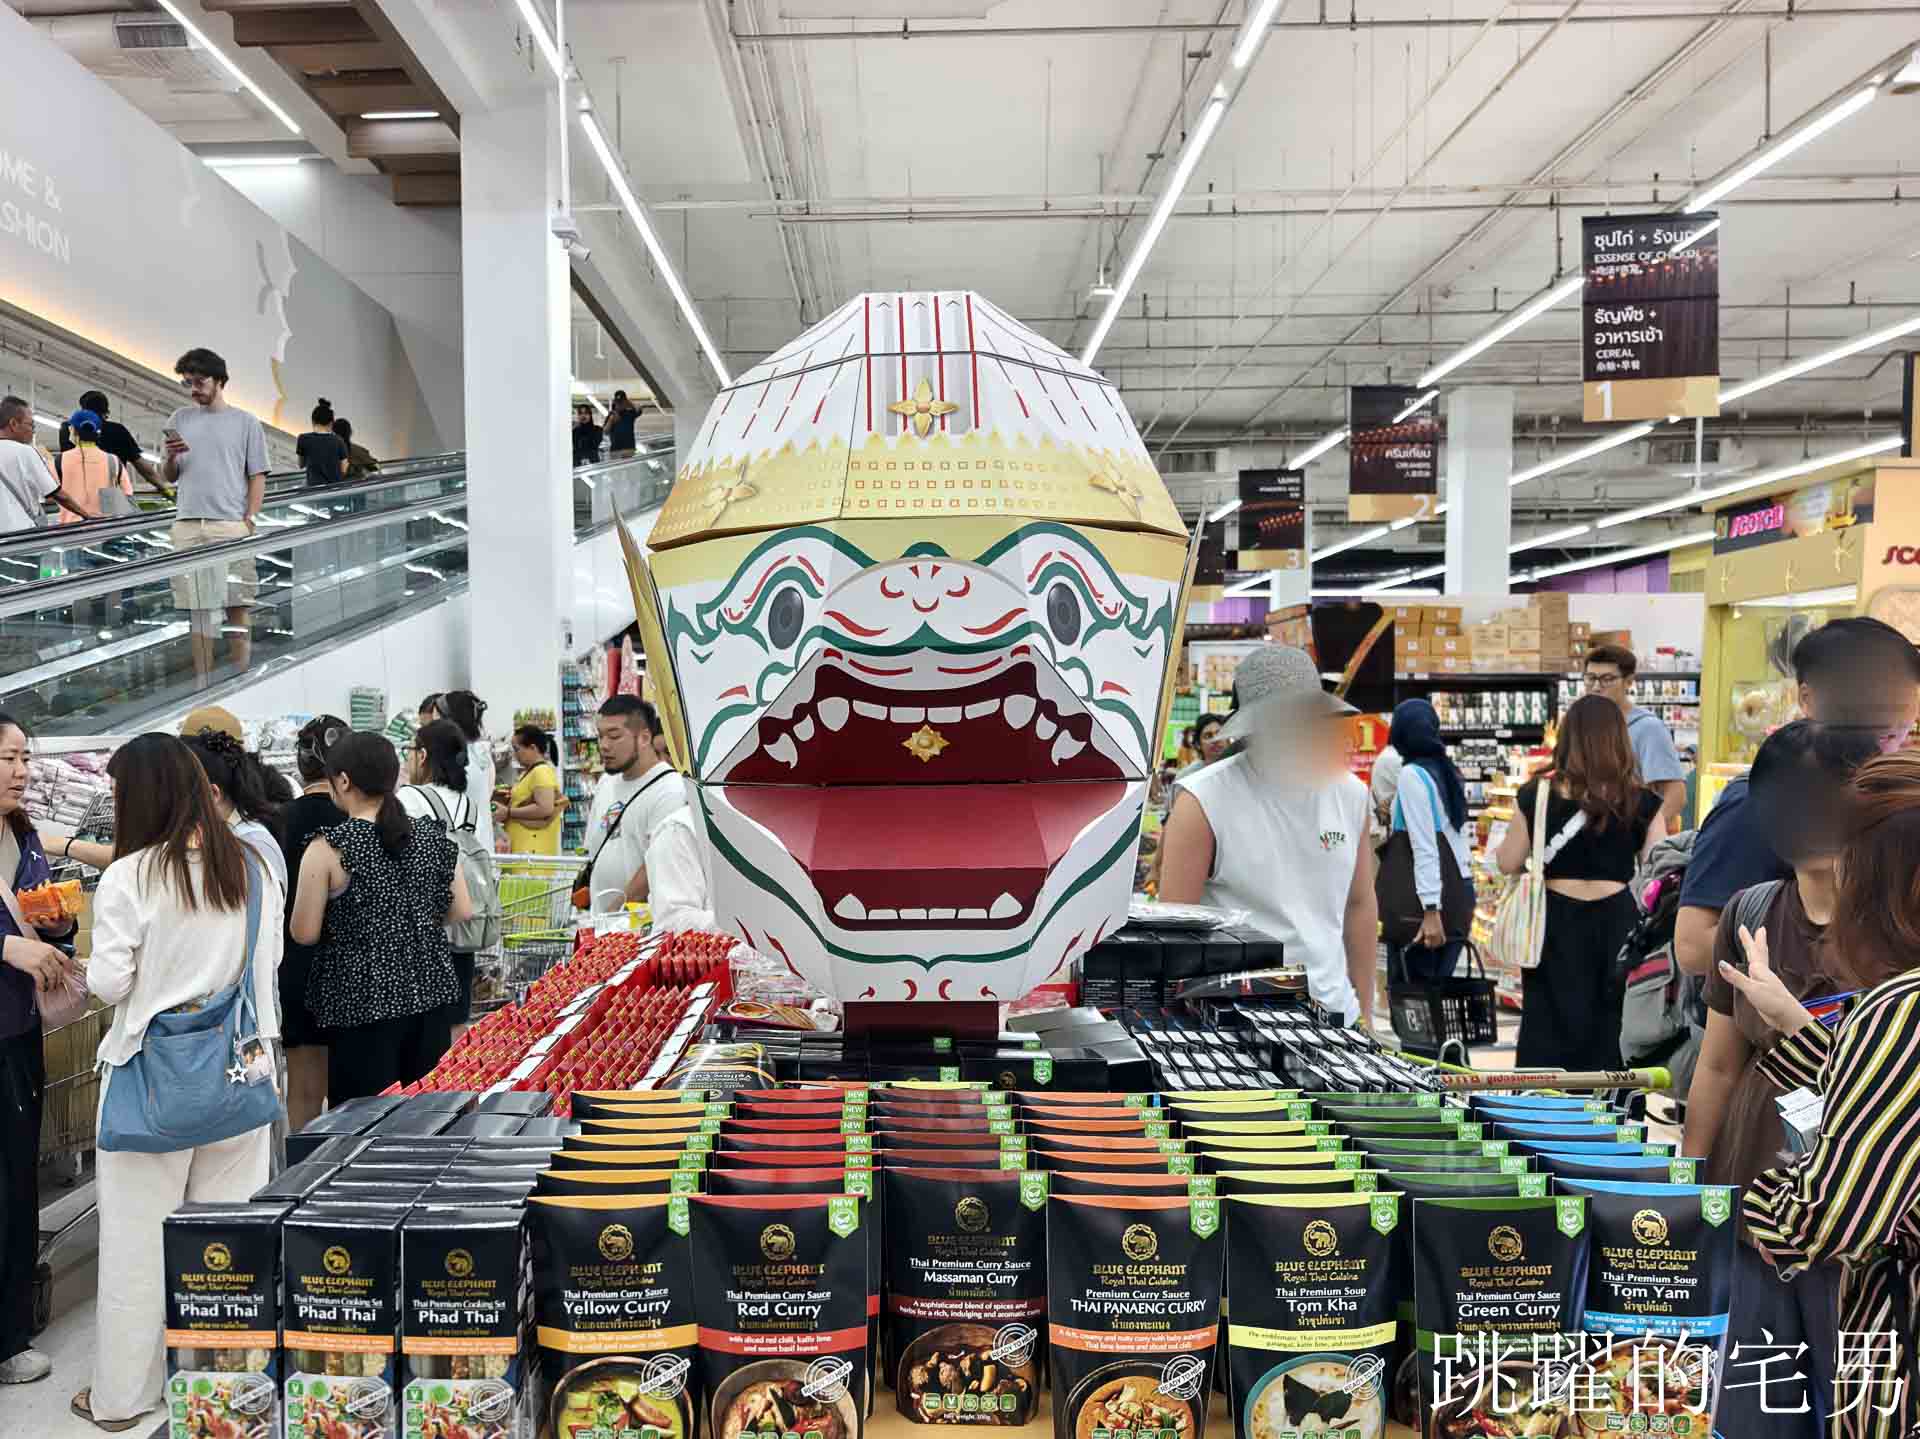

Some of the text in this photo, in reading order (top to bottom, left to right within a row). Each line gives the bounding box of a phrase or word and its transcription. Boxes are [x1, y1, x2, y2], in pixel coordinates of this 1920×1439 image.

[1594, 305, 1643, 324] ธัญพืช
[1594, 326, 1663, 345] อาหารเช้า
[1595, 348, 1634, 359] CEREAL
[1596, 382, 1612, 420] 1
[910, 1258, 1031, 1270] Thai Premium Curry Sauce
[924, 1271, 1018, 1286] Massaman Curry
[1602, 1272, 1697, 1285] Thai Premium Soup
[564, 1288, 669, 1299] Thai Premium Curry Sauce
[727, 1291, 743, 1300] Thai
[783, 1292, 805, 1301] Curry
[807, 1291, 831, 1300] Sauce
[1086, 1289, 1190, 1300] Premium Curry Sauce
[1275, 1287, 1366, 1296] Thai Premium Soup
[1456, 1291, 1560, 1301] Thai Premium Curry Sauce
[1610, 1284, 1689, 1299] Tom Yam
[180, 1304, 258, 1317] Phad Thai
[563, 1300, 671, 1315] Yellow Curry
[738, 1302, 821, 1319] Red Curry
[1070, 1299, 1206, 1314] THAI PANAENG CURRY
[1286, 1298, 1357, 1312] Tom Kha
[1459, 1303, 1560, 1318] Green Curry
[299, 1305, 376, 1321] Phad Thai
[419, 1310, 499, 1323] Phad Thai
